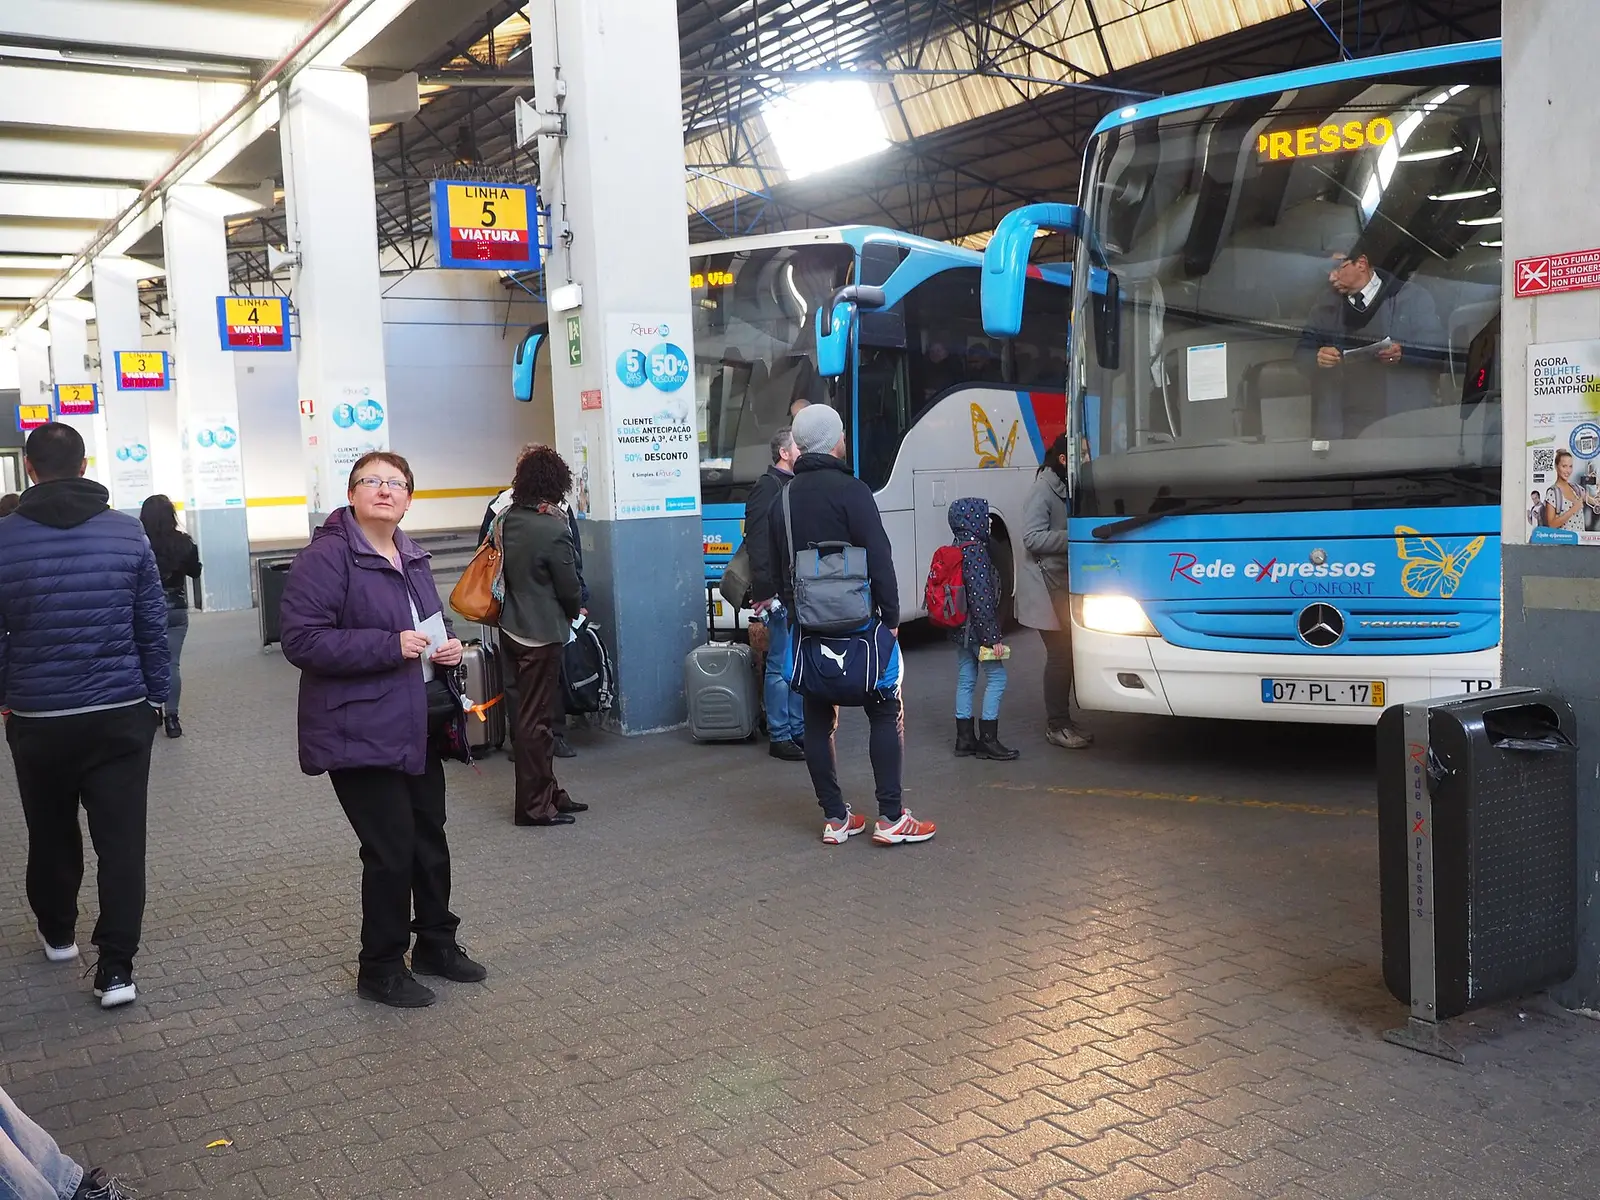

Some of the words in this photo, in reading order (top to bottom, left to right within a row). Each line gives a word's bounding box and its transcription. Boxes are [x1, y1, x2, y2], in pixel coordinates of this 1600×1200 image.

[465, 187, 509, 199] LINHA
[480, 201, 497, 228] 5
[458, 228, 520, 242] VIATURA
[1551, 257, 1569, 267] NÃO
[707, 271, 733, 286] Via
[1551, 269, 1563, 277] NO
[1551, 279, 1569, 287] NON
[237, 299, 269, 307] LINHA
[247, 307, 260, 324] 4
[233, 325, 278, 334] VIATURA
[137, 359, 146, 371] 3
[626, 351, 640, 373] 5
[651, 353, 688, 377] 50%
[1533, 357, 1569, 368] AGORA
[1533, 368, 1542, 377] O
[1543, 365, 1581, 376] BILHETE
[1534, 374, 1556, 387] ESTÁ
[1557, 376, 1573, 385] NO
[1575, 374, 1594, 384] SEU
[72, 390, 80, 400] 2
[1533, 383, 1600, 396] SMARTPHONE
[32, 409, 36, 418] 1
[622, 417, 653, 426] CLIENTE
[617, 427, 622, 435] 5
[623, 427, 640, 435] DIAS
[642, 424, 691, 434] ANTECIPAÇÃO
[617, 435, 650, 444] VIAGENS
[678, 434, 683, 442] E
[624, 453, 643, 462] 50%
[644, 452, 689, 461] DESCONTO
[1168, 552, 1236, 584] Rede
[1289, 579, 1376, 597] CONFORT
[1360, 620, 1461, 629] TOURISMO
